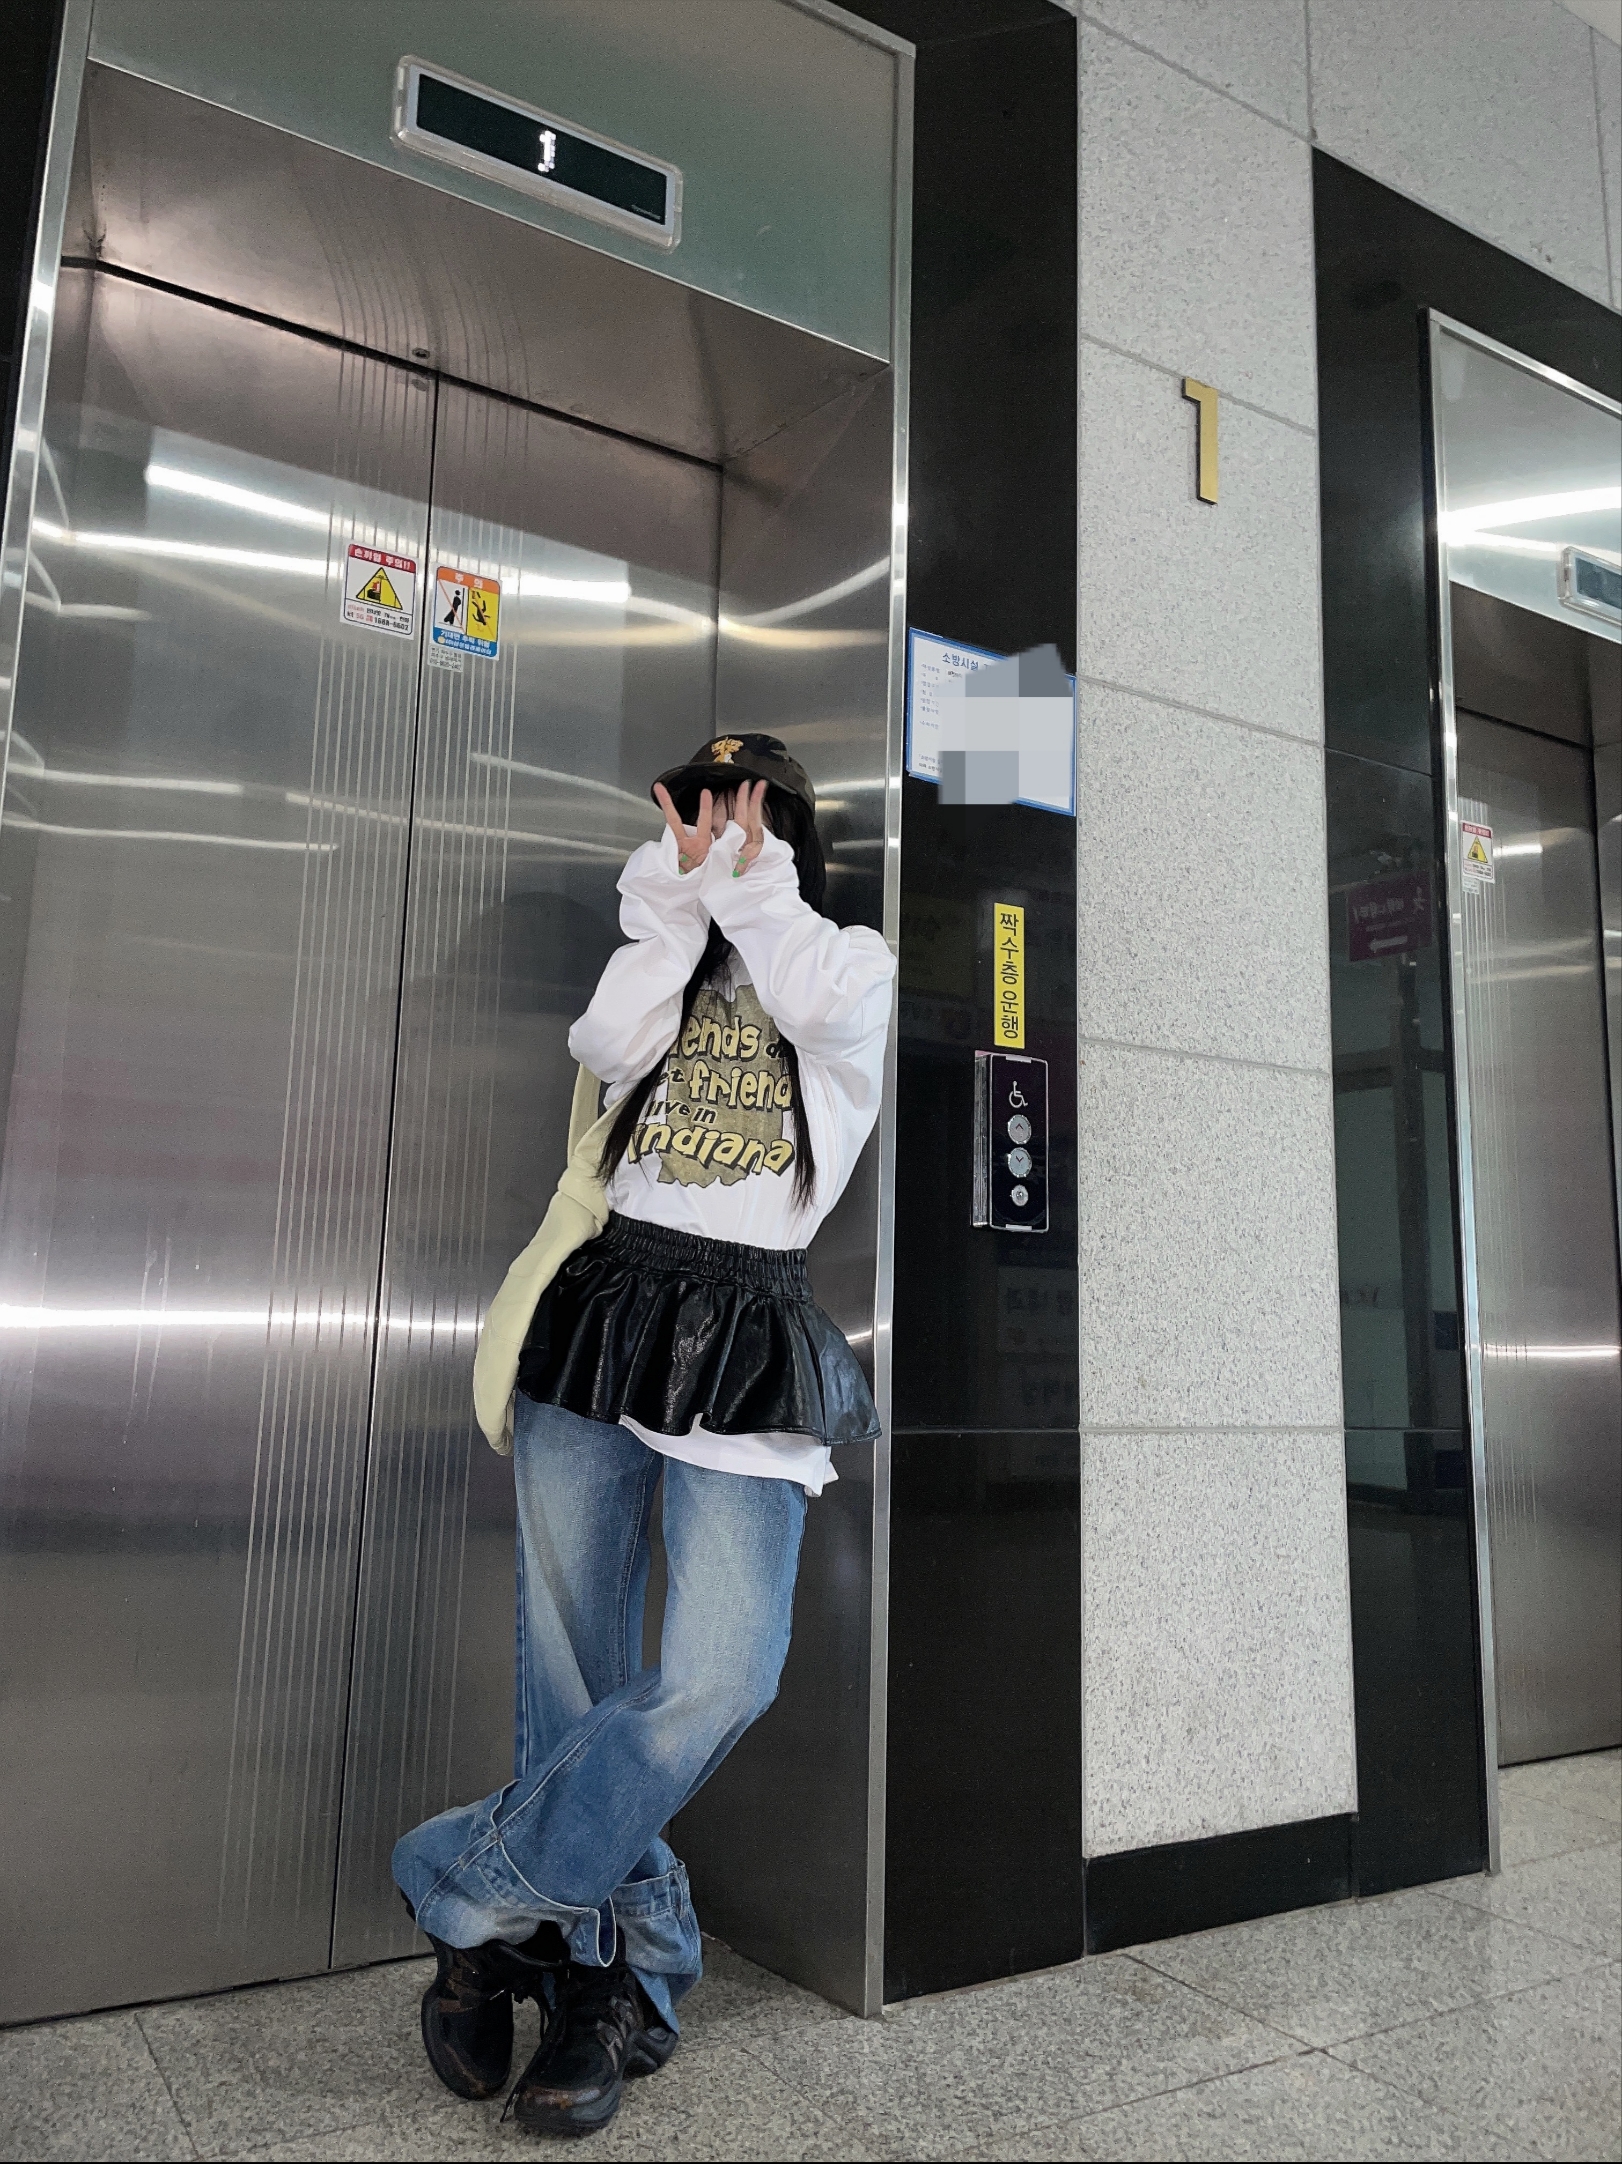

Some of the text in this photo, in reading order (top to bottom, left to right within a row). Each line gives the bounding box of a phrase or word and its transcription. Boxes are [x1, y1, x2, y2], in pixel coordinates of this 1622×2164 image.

[538, 130, 556, 172] 1
[1181, 377, 1219, 506] 1
[942, 652, 979, 671] 소방시설
[669, 1014, 762, 1062] ends
[689, 1059, 793, 1113] friend
[692, 1106, 719, 1125] in
